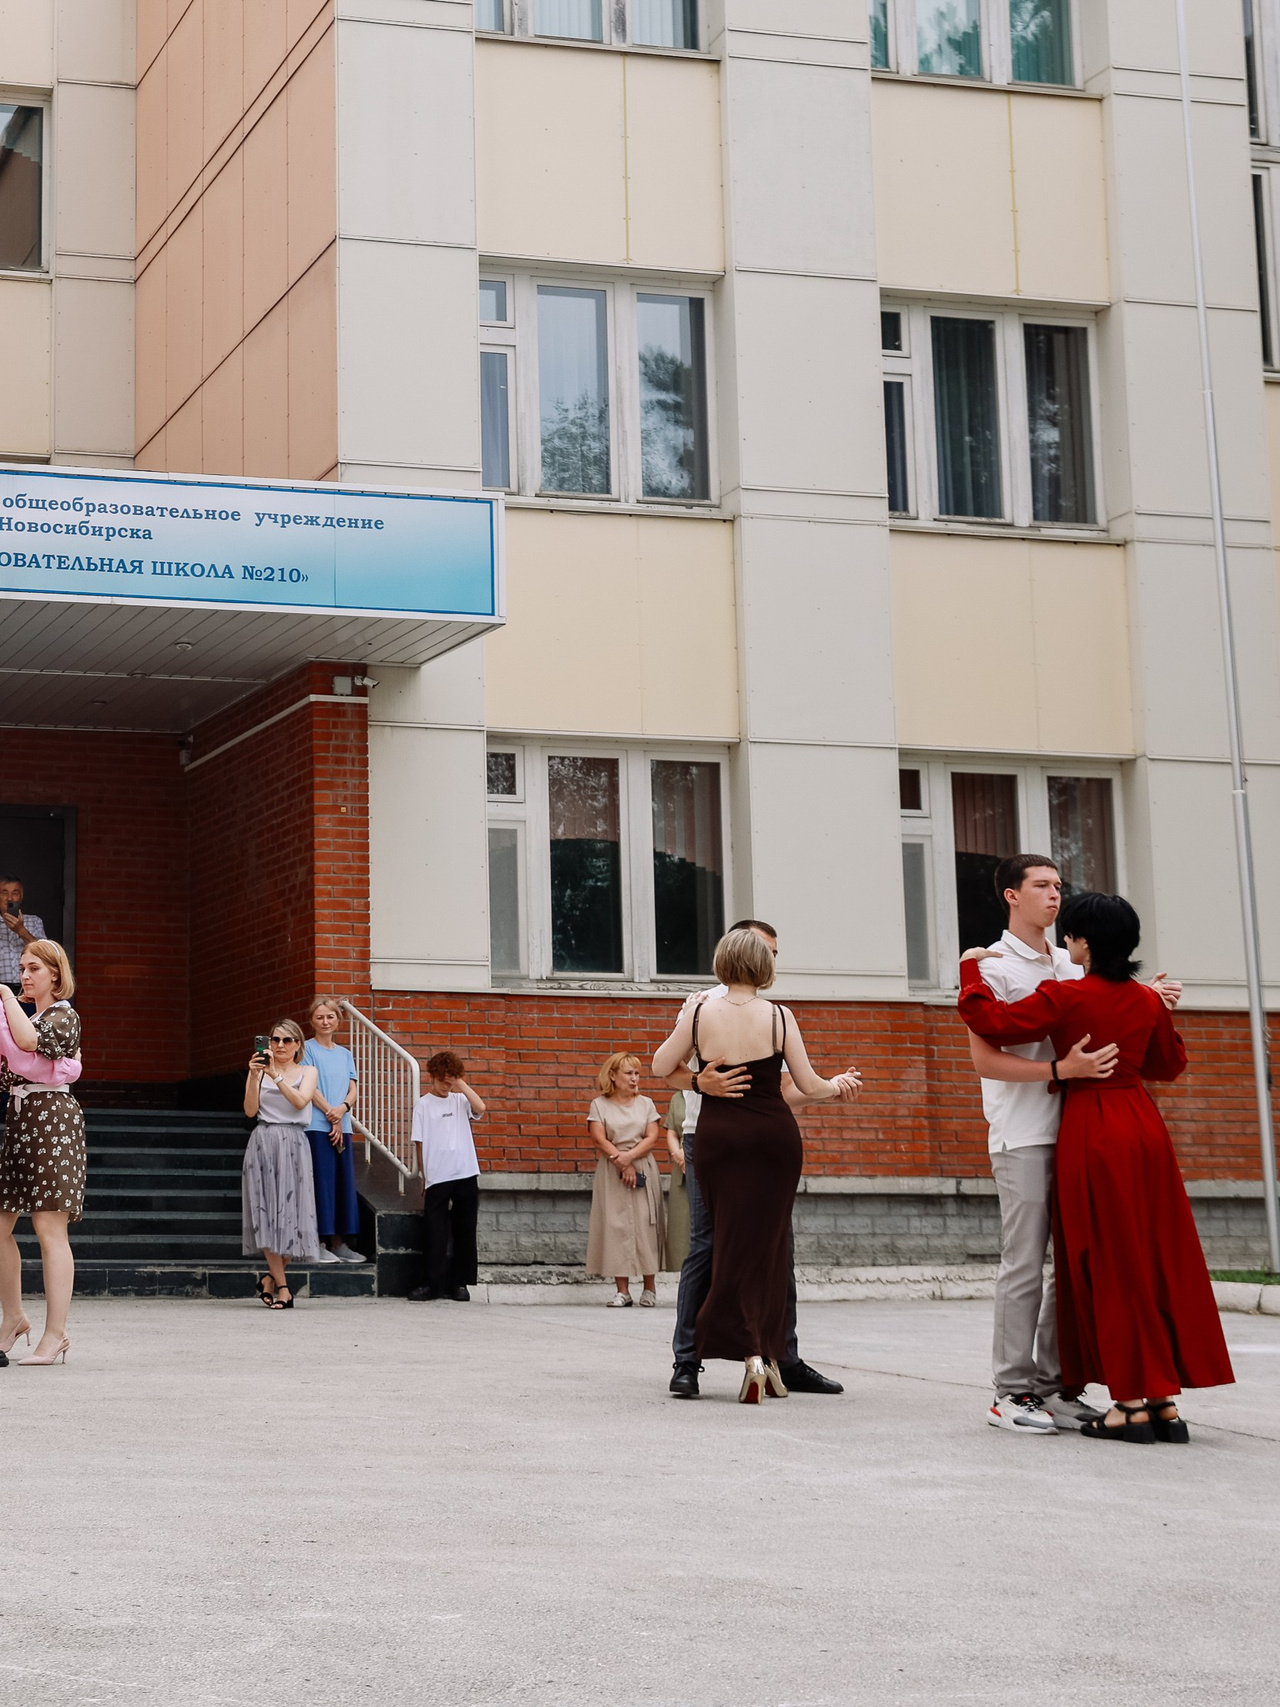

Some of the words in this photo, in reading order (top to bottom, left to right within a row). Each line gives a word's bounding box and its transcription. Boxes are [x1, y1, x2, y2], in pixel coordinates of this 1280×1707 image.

[2, 493, 242, 522] общеобразовательное
[254, 509, 385, 531] учреждение
[151, 560, 235, 580] ШКОЛА
[241, 564, 309, 584] №210»
